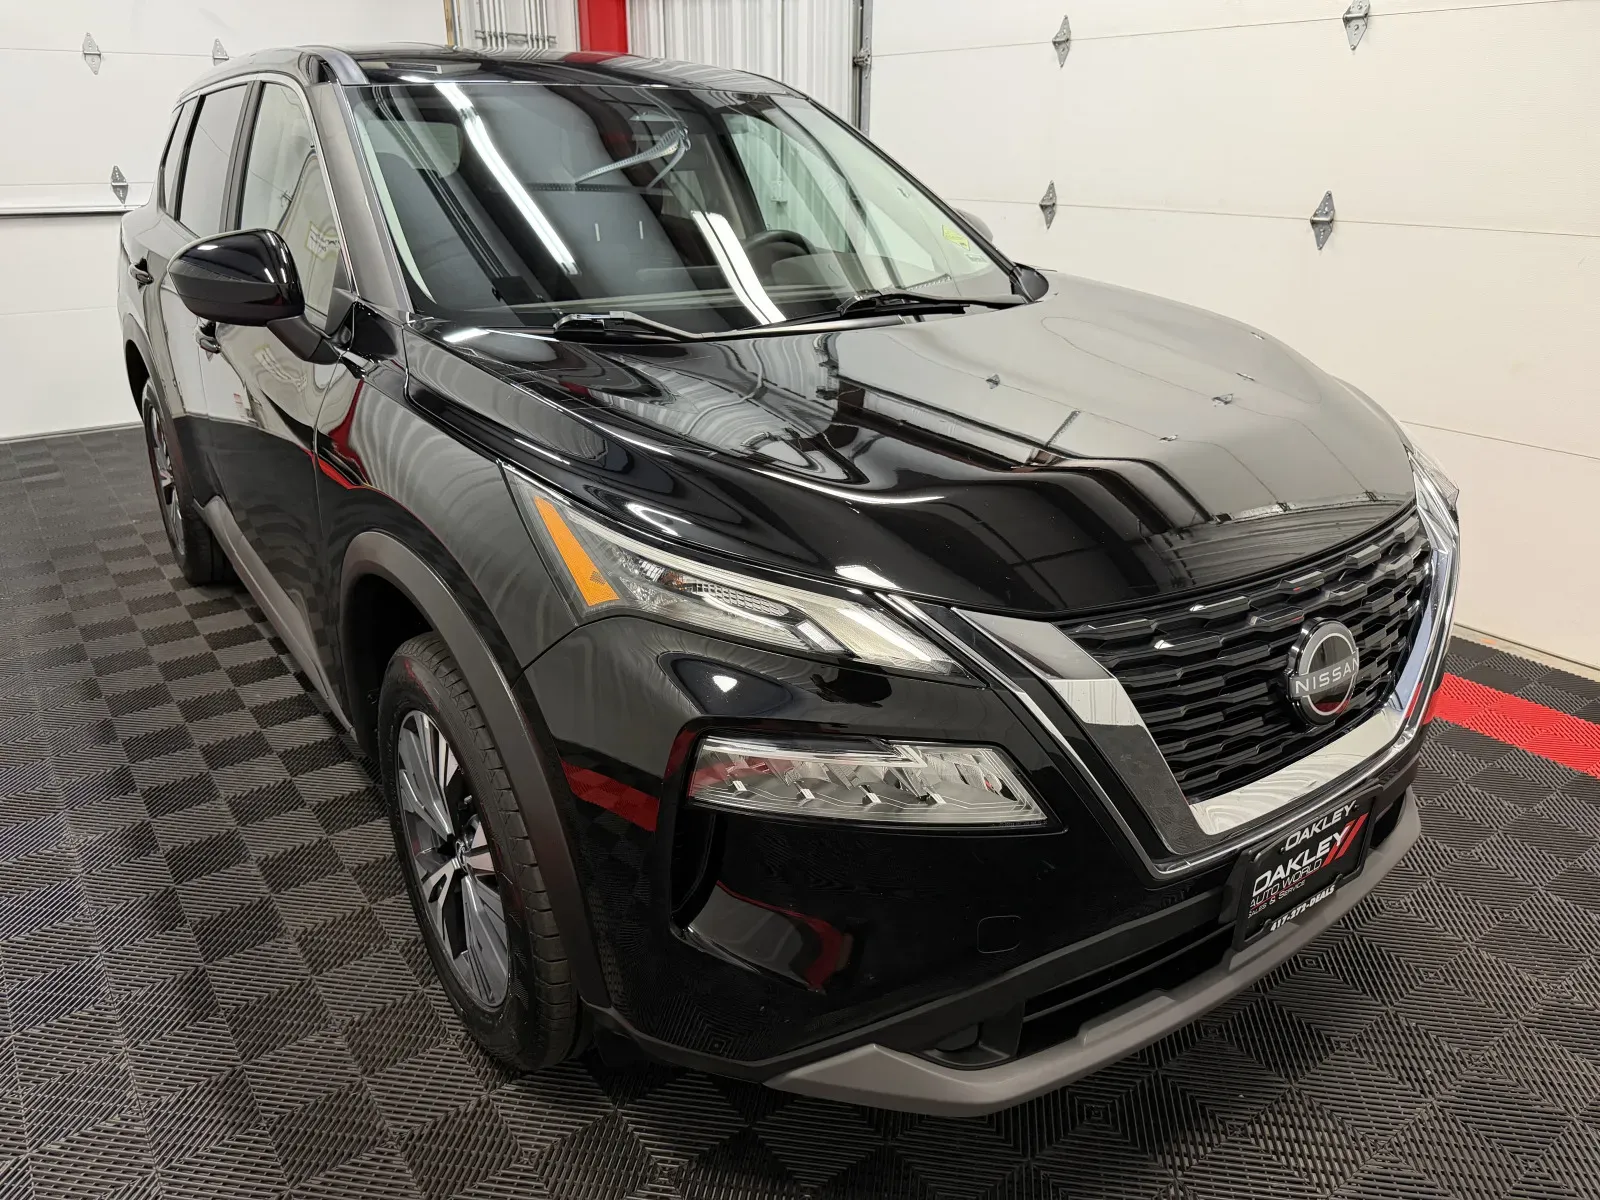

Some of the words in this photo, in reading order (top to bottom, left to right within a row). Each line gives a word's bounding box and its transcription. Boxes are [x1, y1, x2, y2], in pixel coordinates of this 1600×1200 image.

[1295, 657, 1359, 694] NISSAN
[1285, 800, 1357, 852] OAKLEY
[1250, 882, 1280, 908] AUTO
[1282, 858, 1323, 889] WORLD
[1252, 824, 1351, 897] OAKLEY
